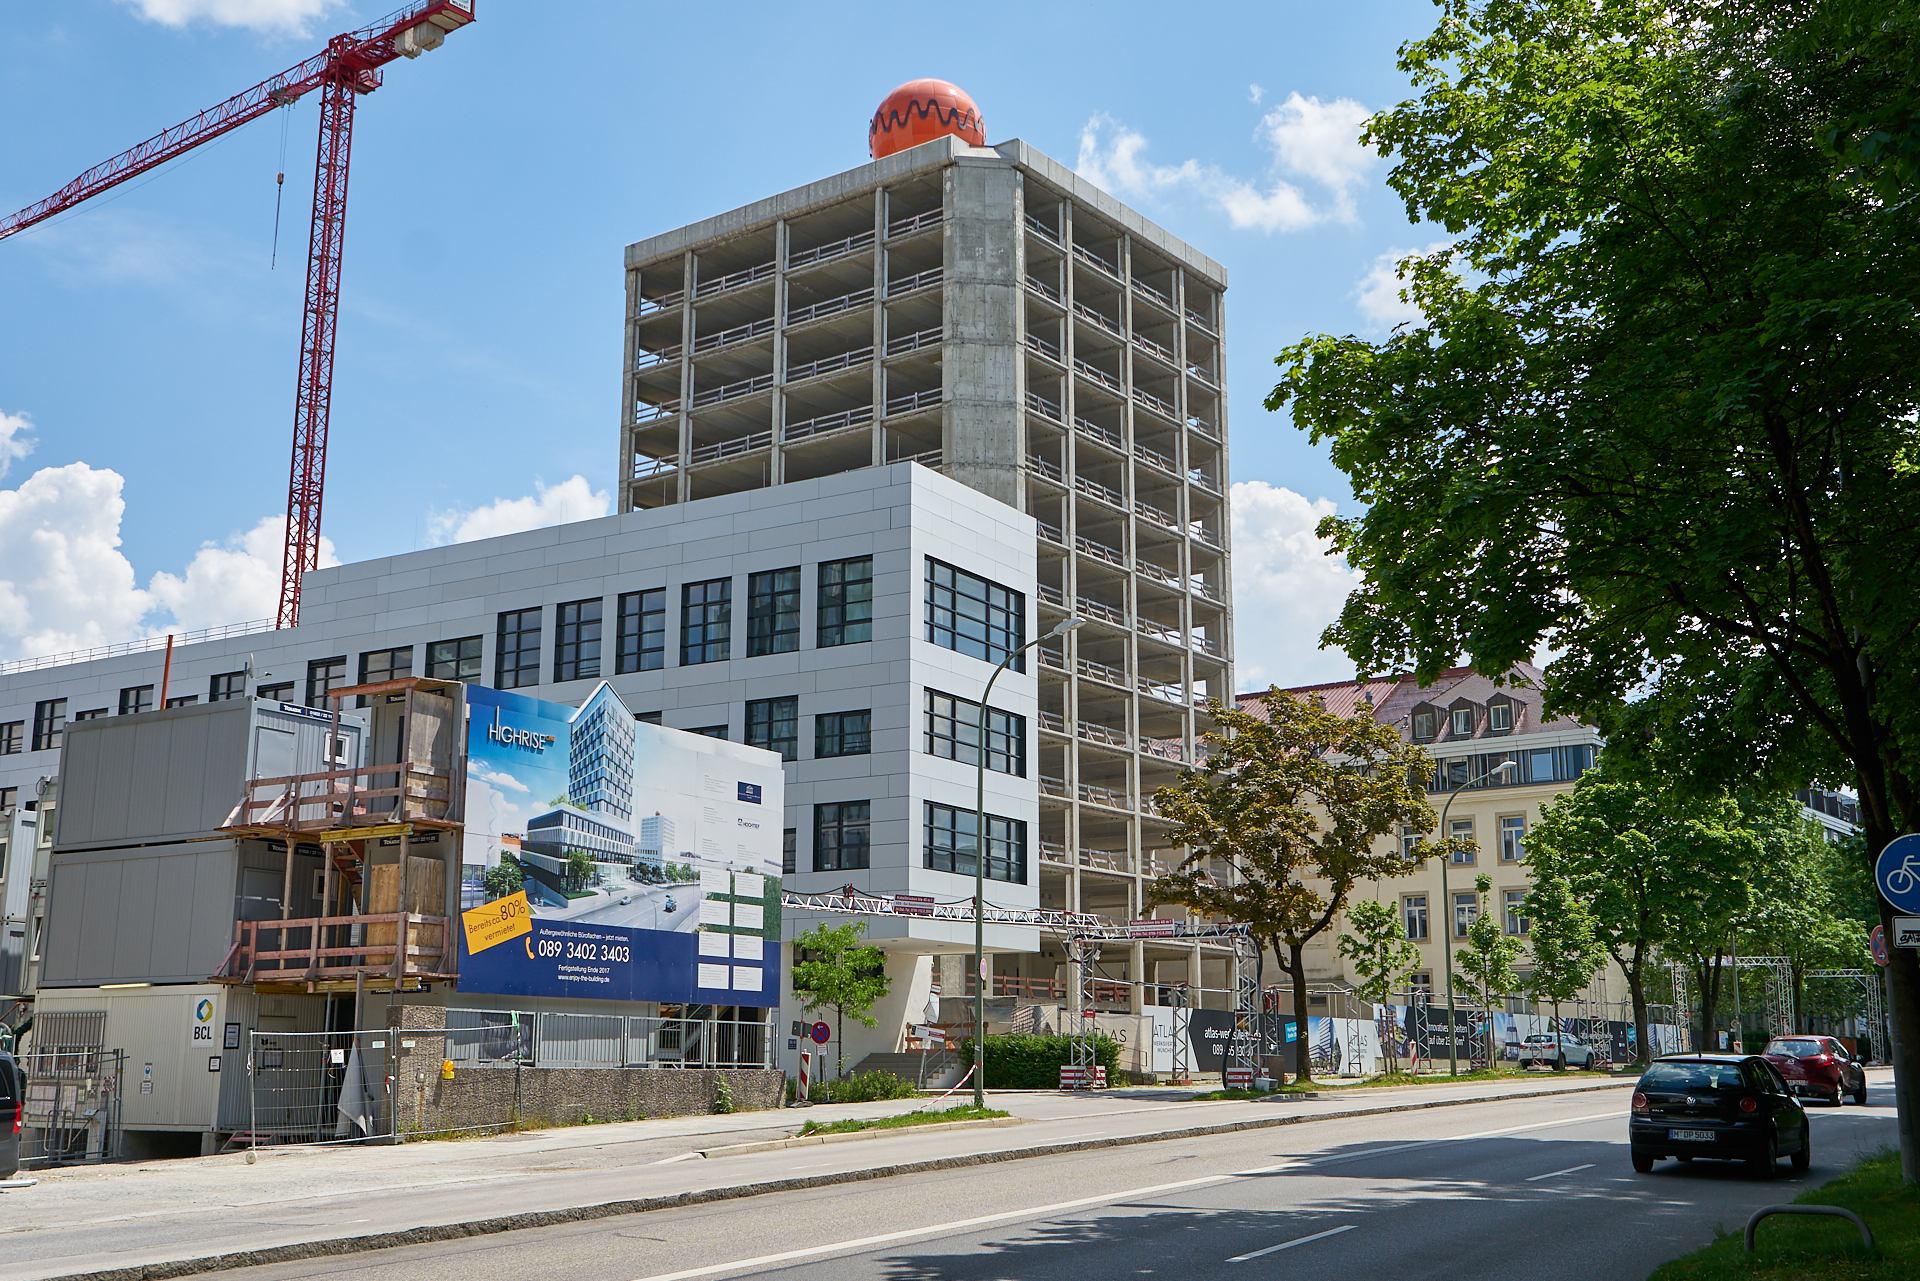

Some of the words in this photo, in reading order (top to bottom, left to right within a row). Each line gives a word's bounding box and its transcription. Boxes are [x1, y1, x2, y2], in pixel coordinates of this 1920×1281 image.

[489, 705, 546, 750] HIGHRISE
[500, 898, 525, 920] 80%
[469, 919, 492, 934] Bereits
[484, 923, 516, 941] vermietet
[539, 940, 562, 958] 089
[567, 942, 596, 960] 3402
[601, 944, 629, 962] 3403
[194, 1026, 212, 1040] BCL
[1213, 1044, 1223, 1055] 089
[1695, 1131, 1714, 1139] 5033
